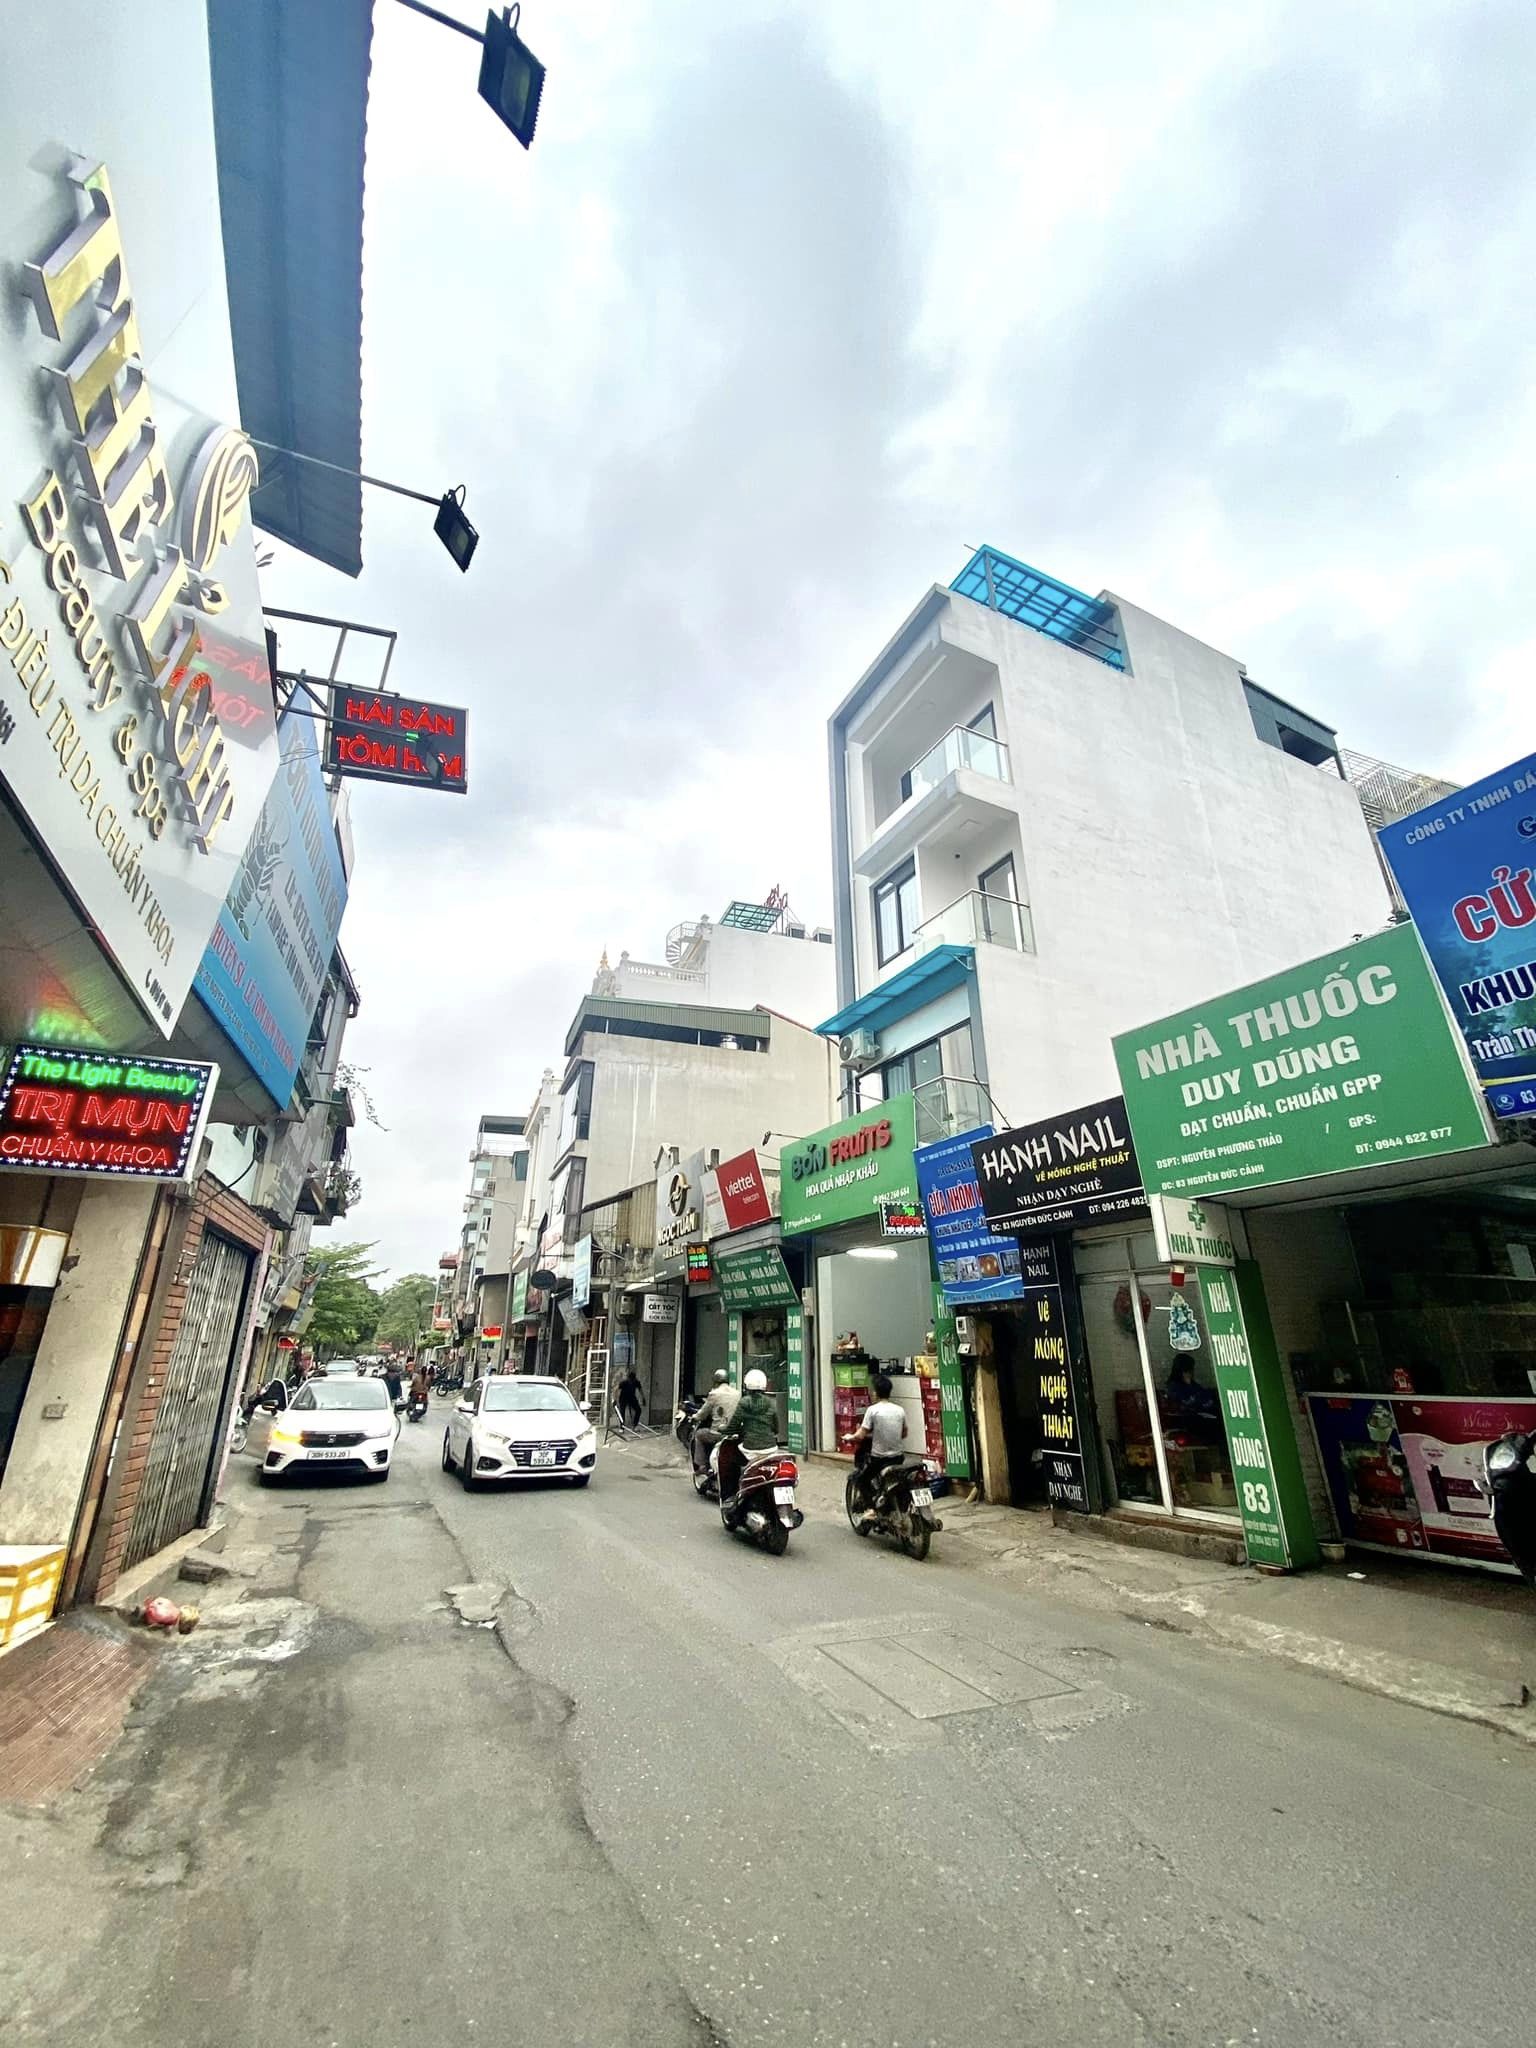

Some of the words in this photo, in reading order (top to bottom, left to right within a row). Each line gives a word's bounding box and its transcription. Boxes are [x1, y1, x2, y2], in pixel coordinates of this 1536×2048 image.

[346, 697, 393, 728] HẢI
[399, 705, 455, 736] SẢN
[336, 734, 397, 768] TÔM
[402, 746, 462, 779] HM
[70, 751, 101, 819] DA
[1405, 817, 1446, 845] CÔNG
[1447, 808, 1465, 825] TY
[1468, 785, 1512, 815] TNHH
[137, 883, 153, 915] Y
[143, 898, 175, 967] KHOA
[1135, 1022, 1223, 1080] NHÀ
[1227, 962, 1398, 1049] THUỐC
[1471, 1031, 1515, 1061] Trần
[23, 1055, 66, 1079] The
[68, 1061, 122, 1088] Light
[125, 1068, 198, 1096] Beauty
[1181, 1068, 1241, 1107] DUY
[1252, 1035, 1360, 1088] DŨNG
[14, 1088, 74, 1131] TRỊ
[81, 1095, 189, 1137] MỤN
[1180, 1118, 1208, 1137] ĐẠT
[1275, 1083, 1338, 1114] CHUẨN
[1342, 1073, 1383, 1098] GPP
[1348, 1114, 1377, 1129] GPS:
[1, 1132, 85, 1161] CHUẨN
[90, 1142, 105, 1161] Y
[106, 1144, 168, 1167] KHOA
[981, 1133, 1053, 1185] HẠNH
[1053, 1115, 1126, 1163] NAIL
[1375, 1136, 1403, 1151] 0944
[1405, 1131, 1429, 1145] 622
[1430, 1126, 1453, 1140] 677
[1100, 1151, 1131, 1167] THUẬT
[725, 1171, 757, 1198] viettel
[805, 1182, 820, 1198] HOA
[1046, 1187, 1069, 1202] DẠY
[1101, 1201, 1116, 1213] 094
[1116, 1199, 1130, 1210] 226
[1023, 1245, 1050, 1265] HẠNH
[1170, 1232, 1195, 1255] NHÀ
[1196, 1233, 1233, 1260] THUỐC
[1026, 1262, 1050, 1278] NAIL
[1207, 1274, 1232, 1314] NHÀ
[1034, 1330, 1065, 1366] MÓNG
[1212, 1322, 1247, 1367] THUỐC
[1227, 1389, 1251, 1419] DUY
[1232, 1431, 1266, 1469] DŨNG
[1242, 1481, 1271, 1514] 83
